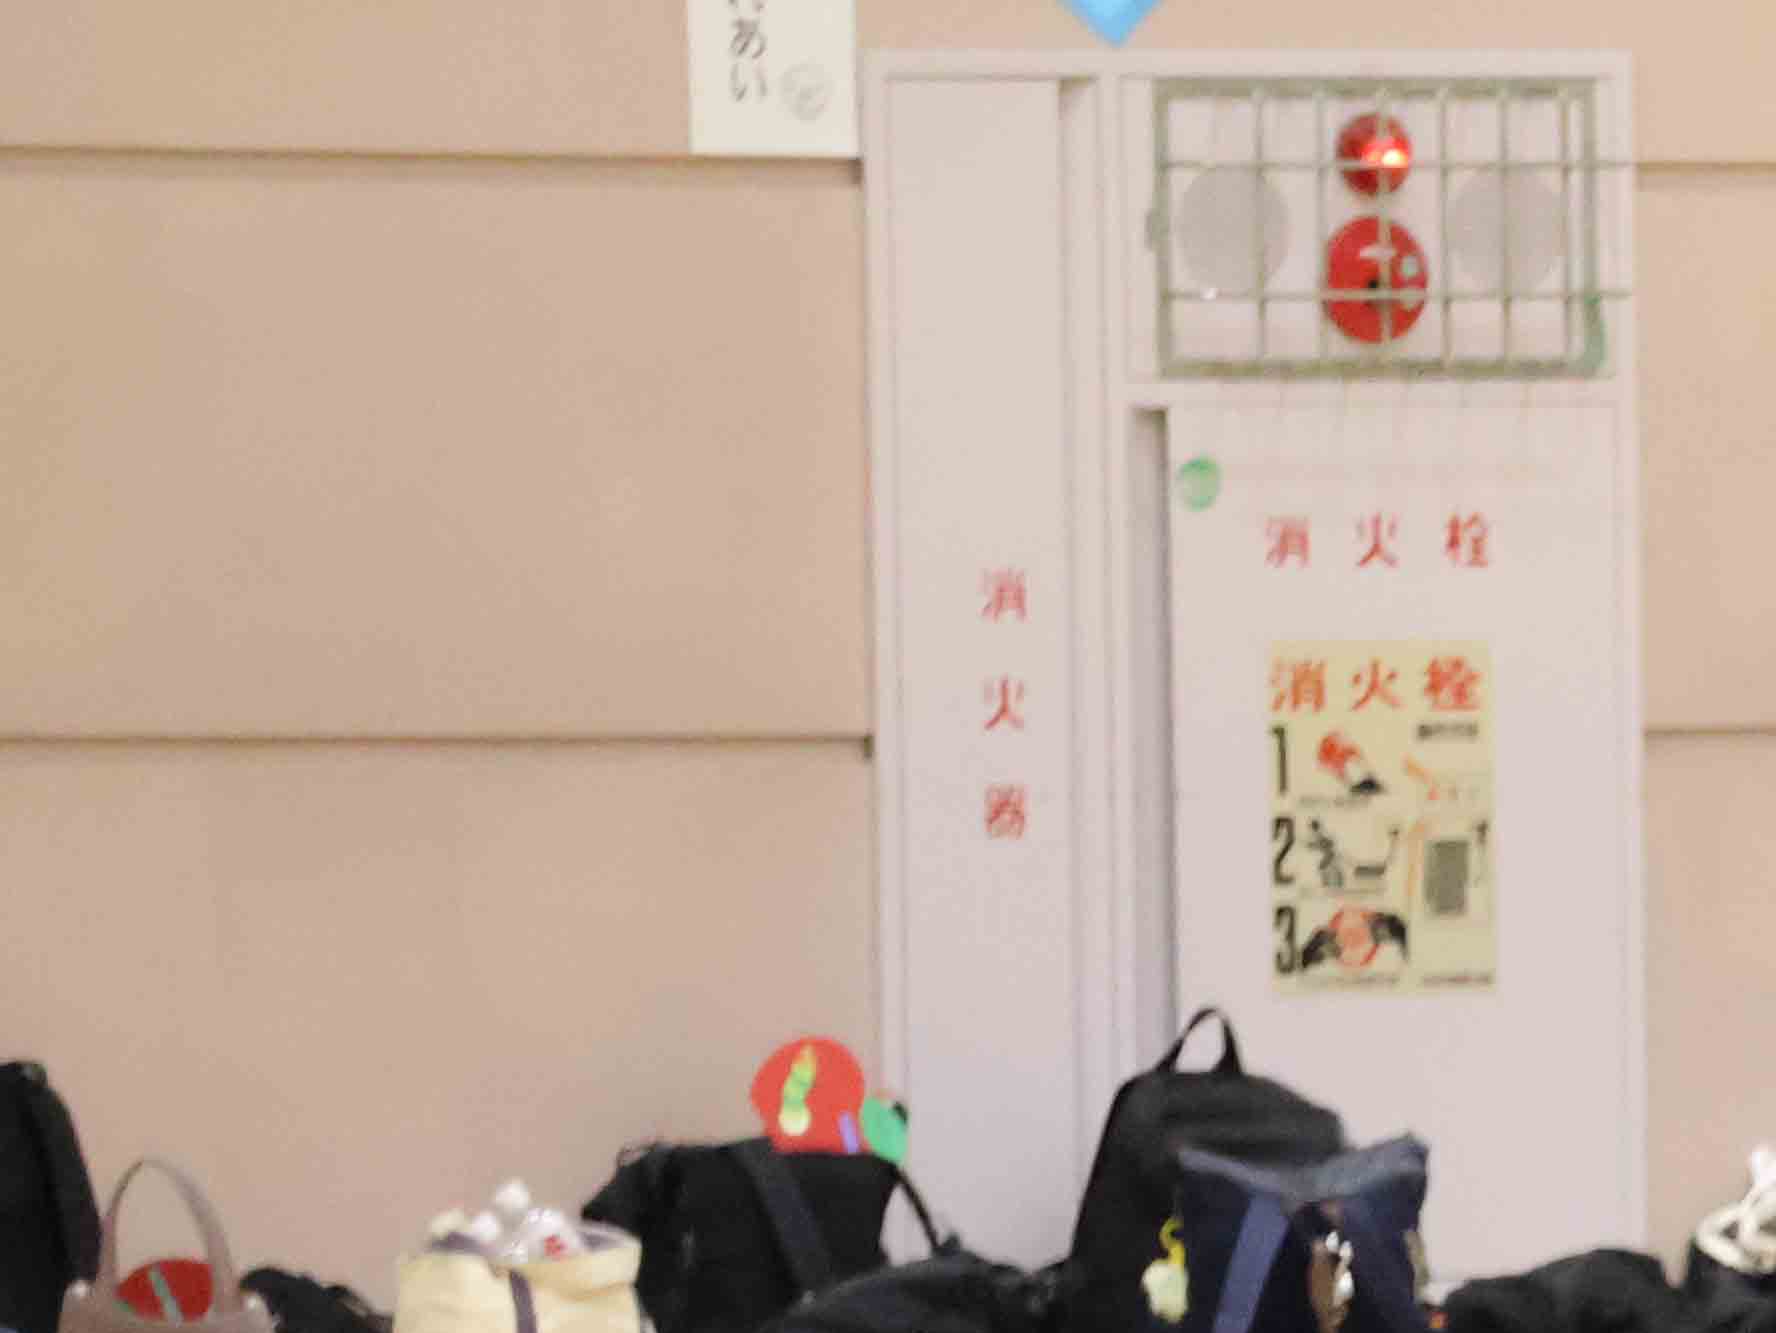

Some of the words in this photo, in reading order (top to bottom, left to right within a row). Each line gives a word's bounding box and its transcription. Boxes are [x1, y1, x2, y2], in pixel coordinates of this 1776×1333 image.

[728, 0, 768, 103] あい
[1265, 511, 1489, 569] 消火栓
[981, 567, 1027, 839] 消火器
[1272, 656, 1482, 713] 消火栓
[1271, 725, 1288, 794] 1
[1273, 816, 1295, 886] 2
[1275, 905, 1296, 974] 3
